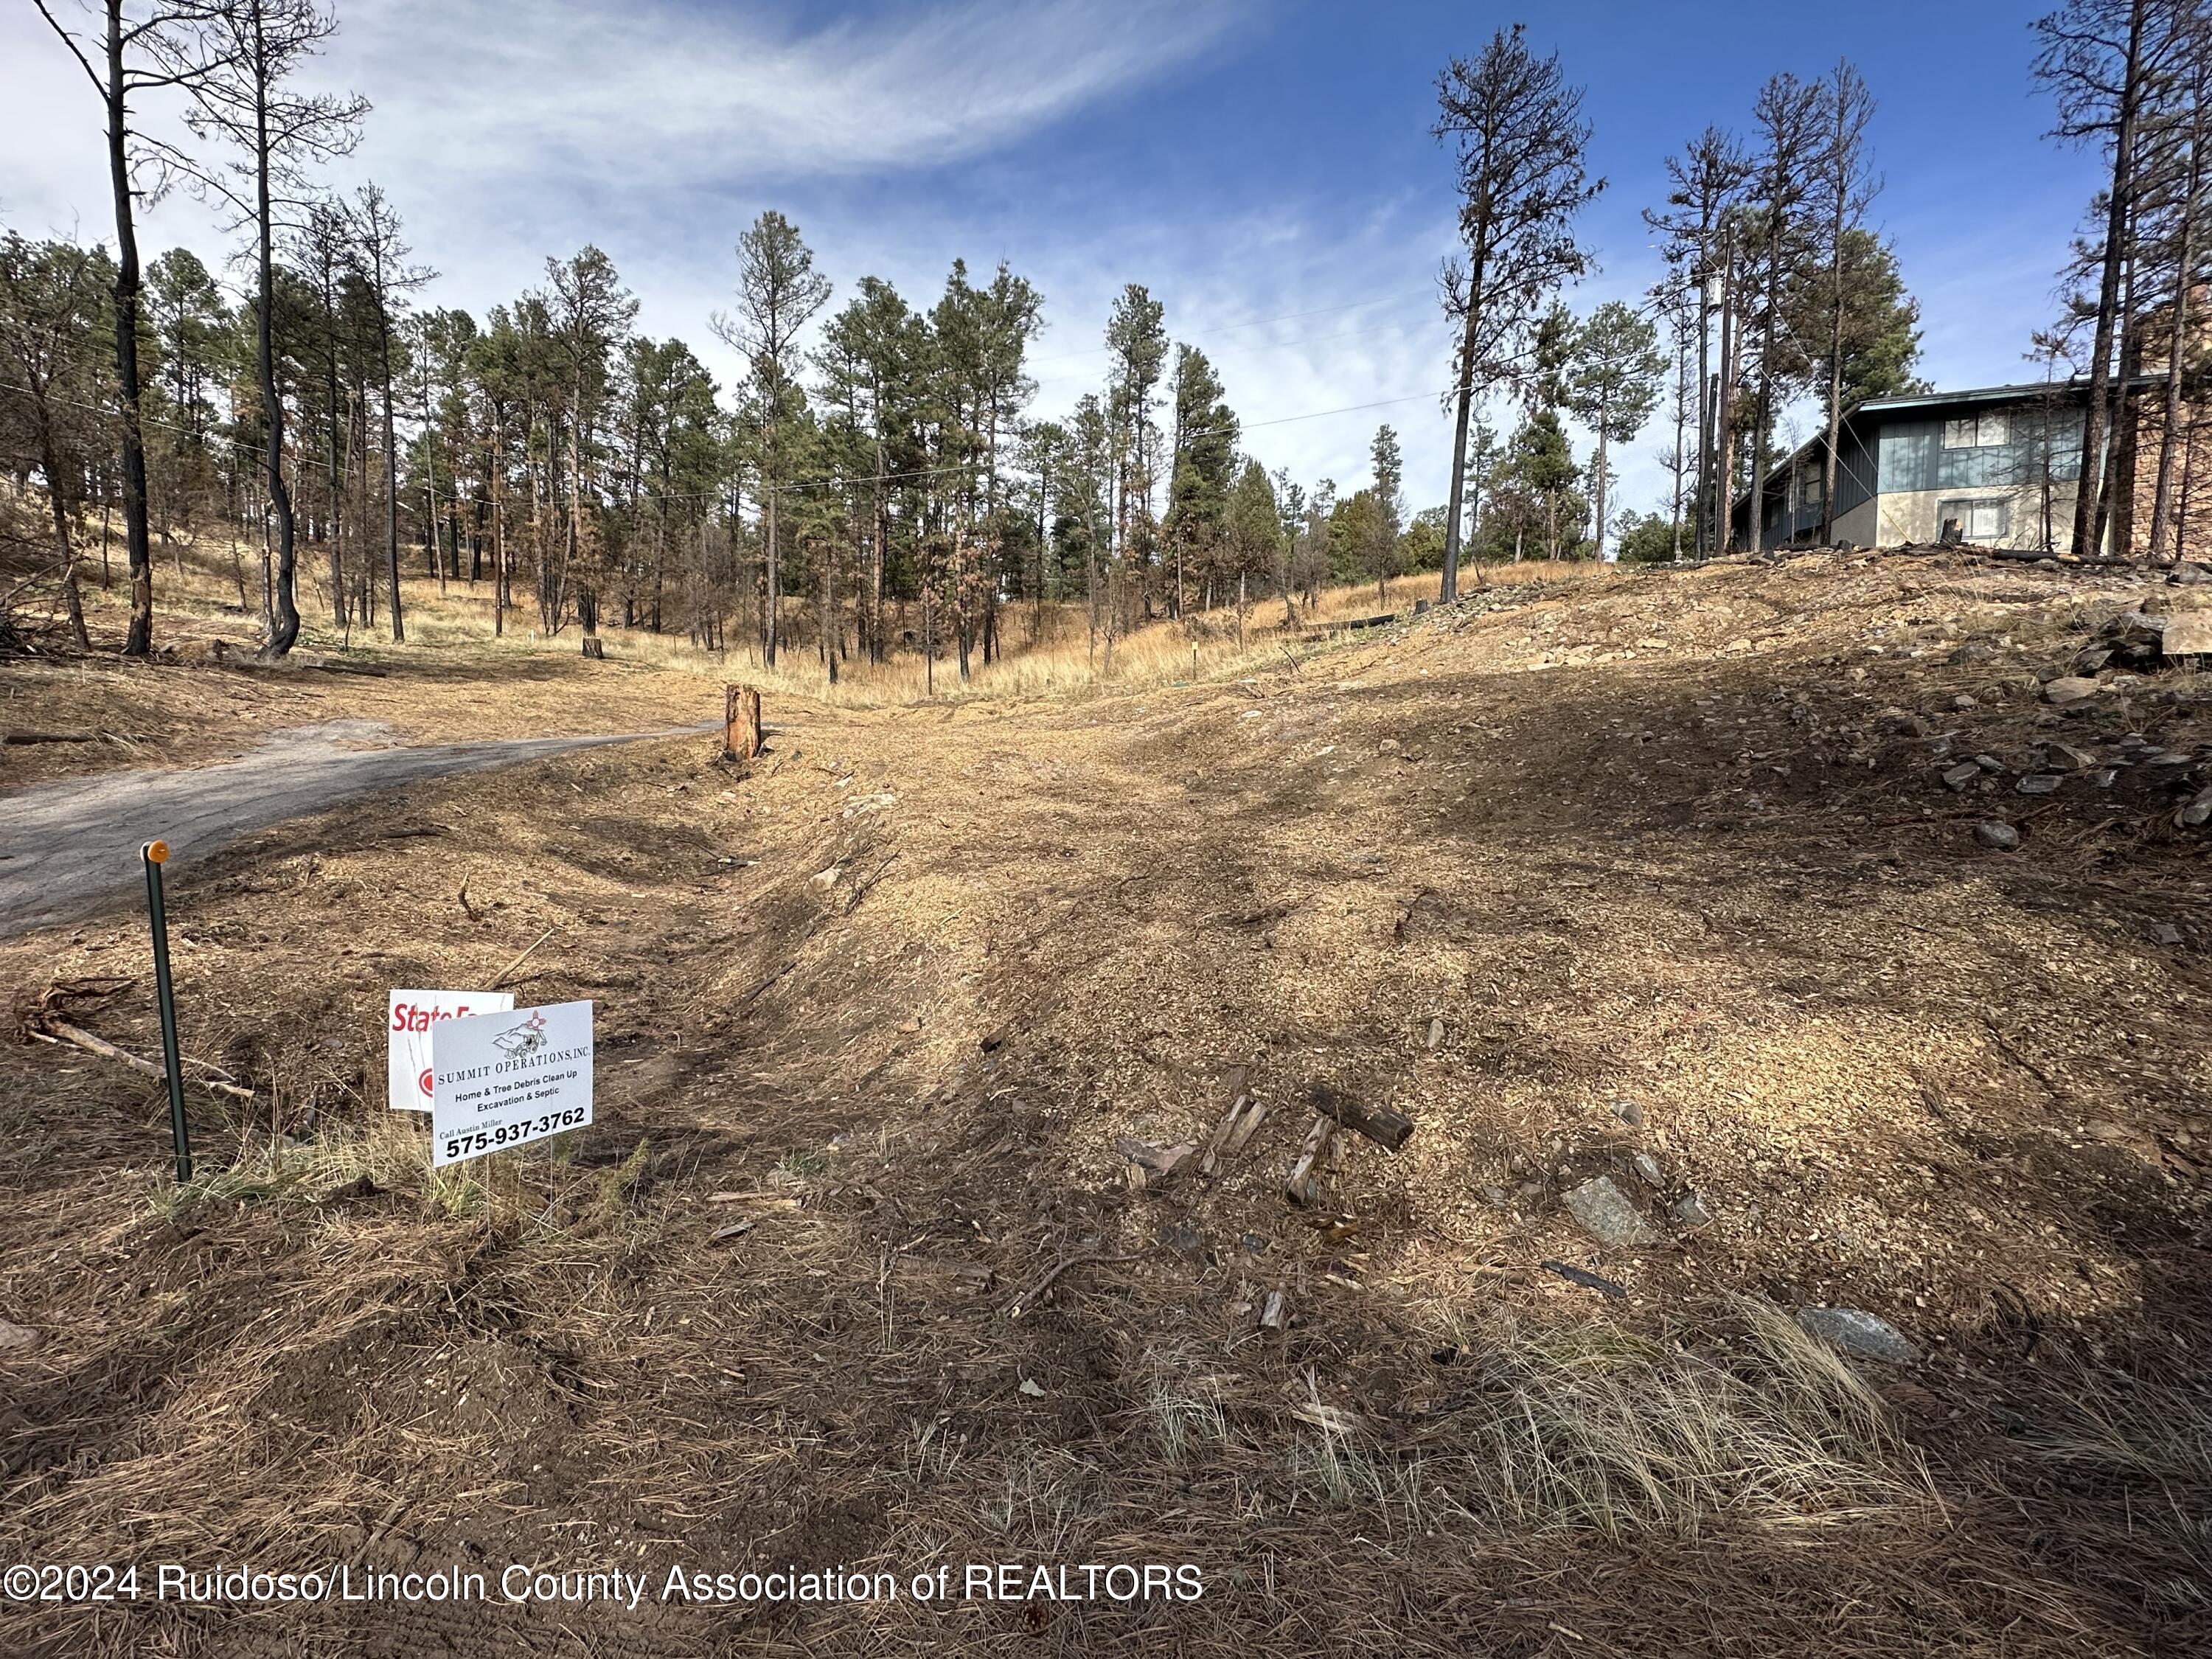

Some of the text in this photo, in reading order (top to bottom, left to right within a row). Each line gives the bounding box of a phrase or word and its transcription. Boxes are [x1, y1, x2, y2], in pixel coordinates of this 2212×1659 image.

[438, 1066, 490, 1085] SUMMIT
[455, 1070, 577, 1102] Home & Tree Debris Clean Up
[477, 1095, 524, 1112] Excavation
[535, 1087, 560, 1099] Septic
[439, 1119, 503, 1140] Call Austin Miller
[446, 1107, 585, 1158] 575-937-3762
